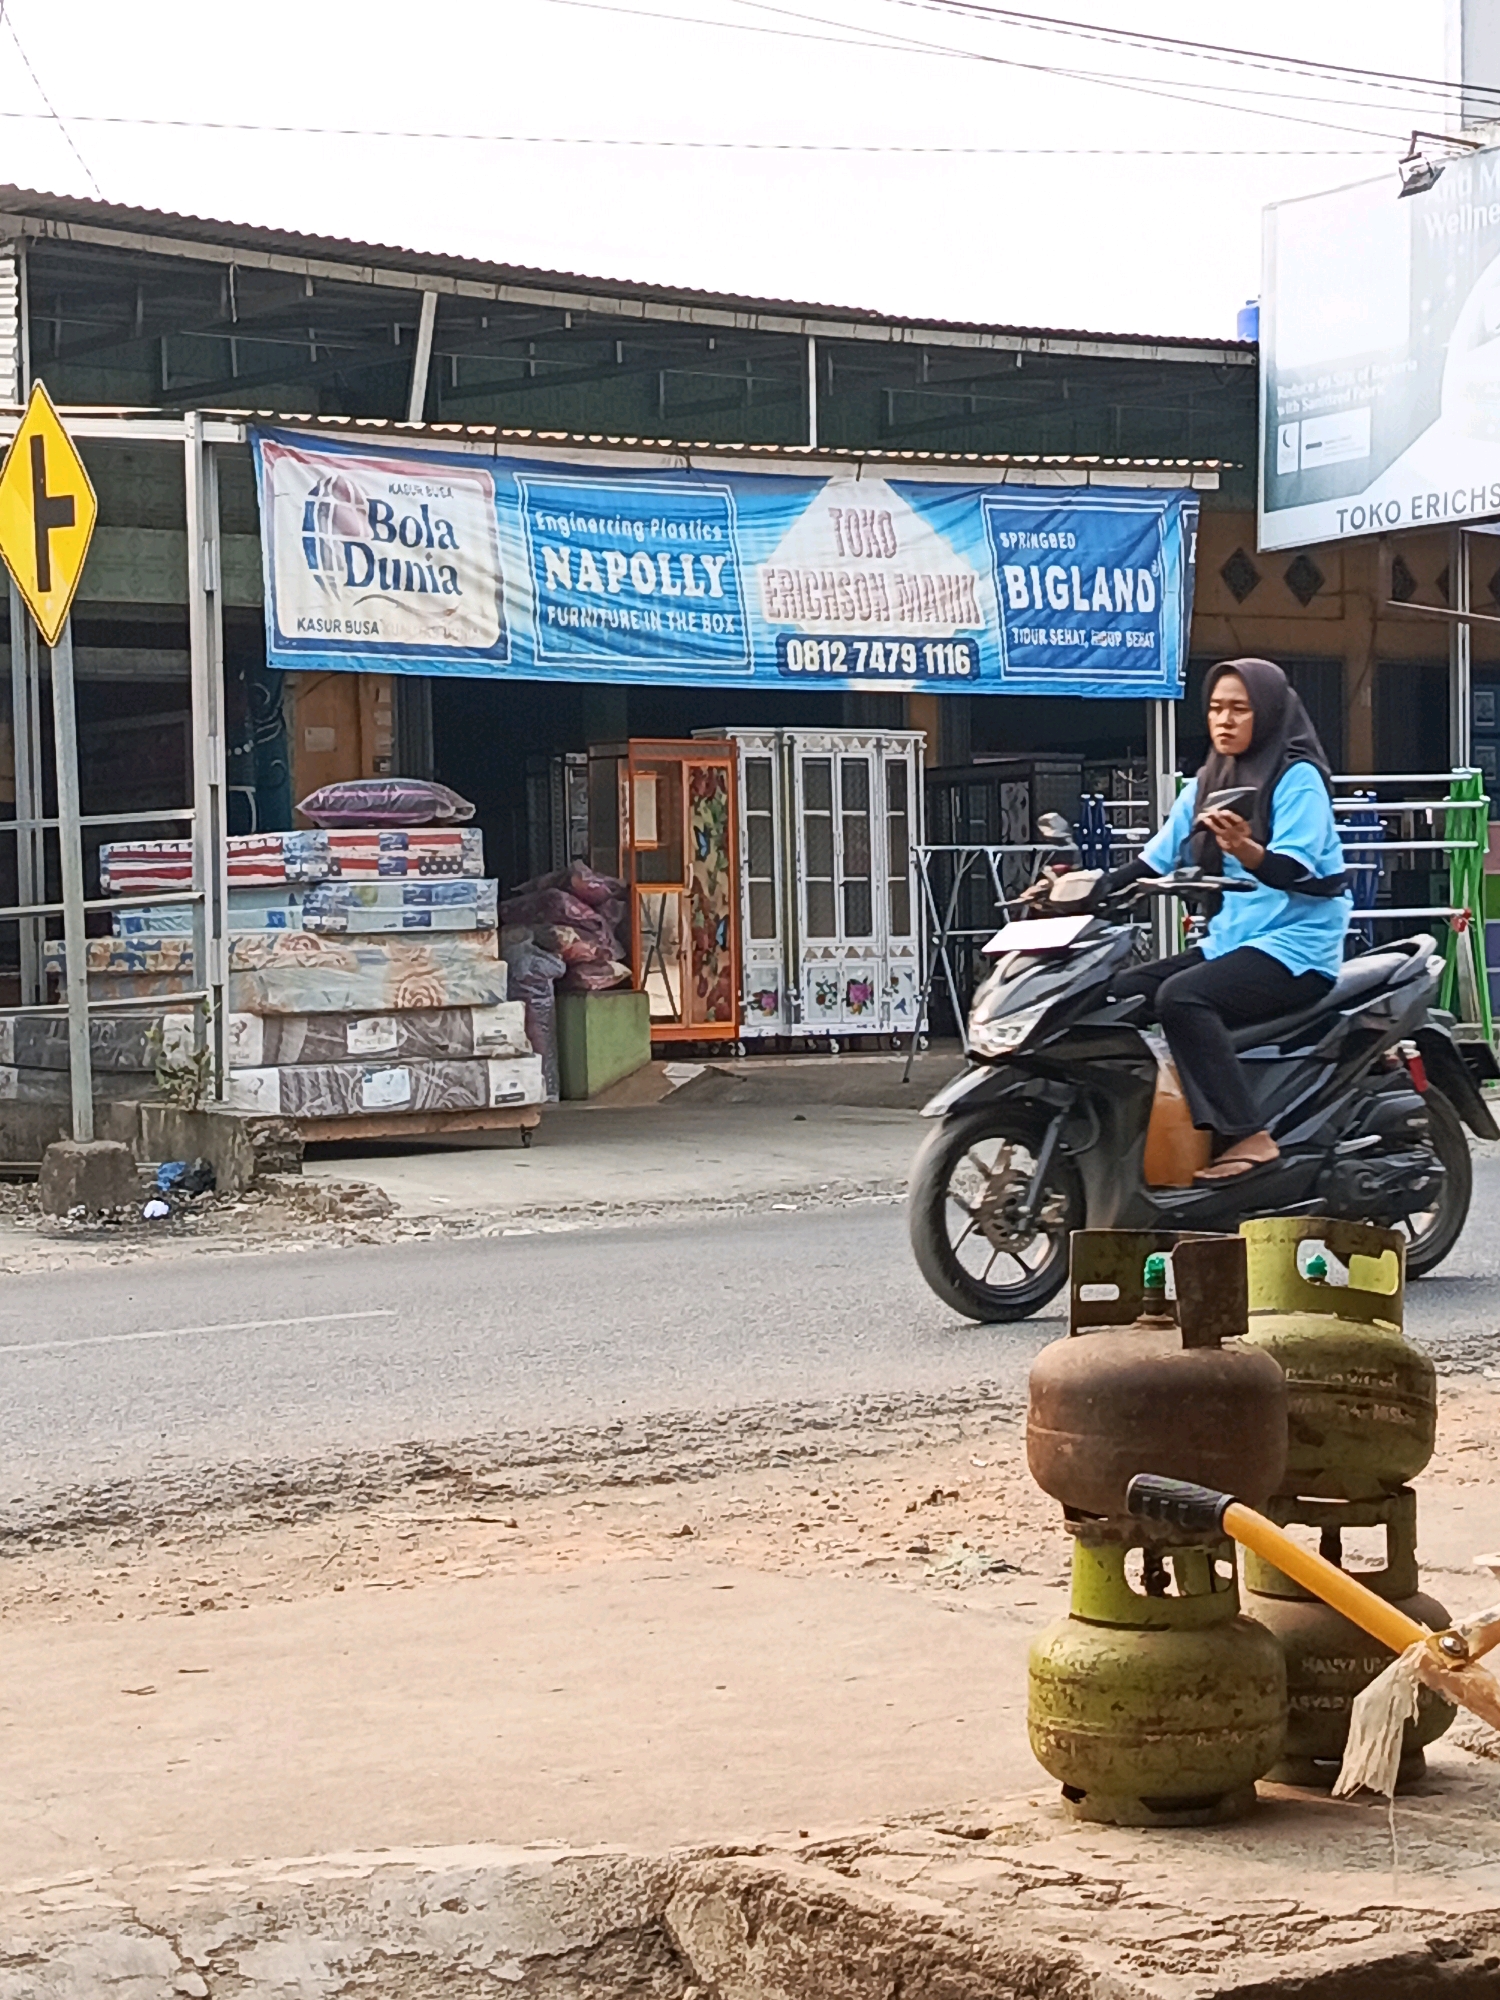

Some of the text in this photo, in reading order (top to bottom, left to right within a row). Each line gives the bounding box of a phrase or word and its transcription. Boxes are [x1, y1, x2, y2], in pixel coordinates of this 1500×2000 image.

[366, 498, 460, 550] Bola
[534, 511, 722, 542] Engineering Plastics
[1336, 482, 1500, 533] TOKO ERICHS
[828, 507, 897, 559] TOKO
[1000, 531, 1076, 550] SPRINGBED
[342, 540, 463, 596] Dunia
[541, 546, 726, 598] NAPOLLY
[1003, 564, 1156, 613] BIGLAND
[547, 605, 735, 634] FURNITURE IN THE BOX
[762, 568, 890, 621] ERICHSON
[297, 617, 342, 633] KASUR
[345, 618, 380, 636] BUSA
[786, 639, 971, 675] 0812 7479 1116
